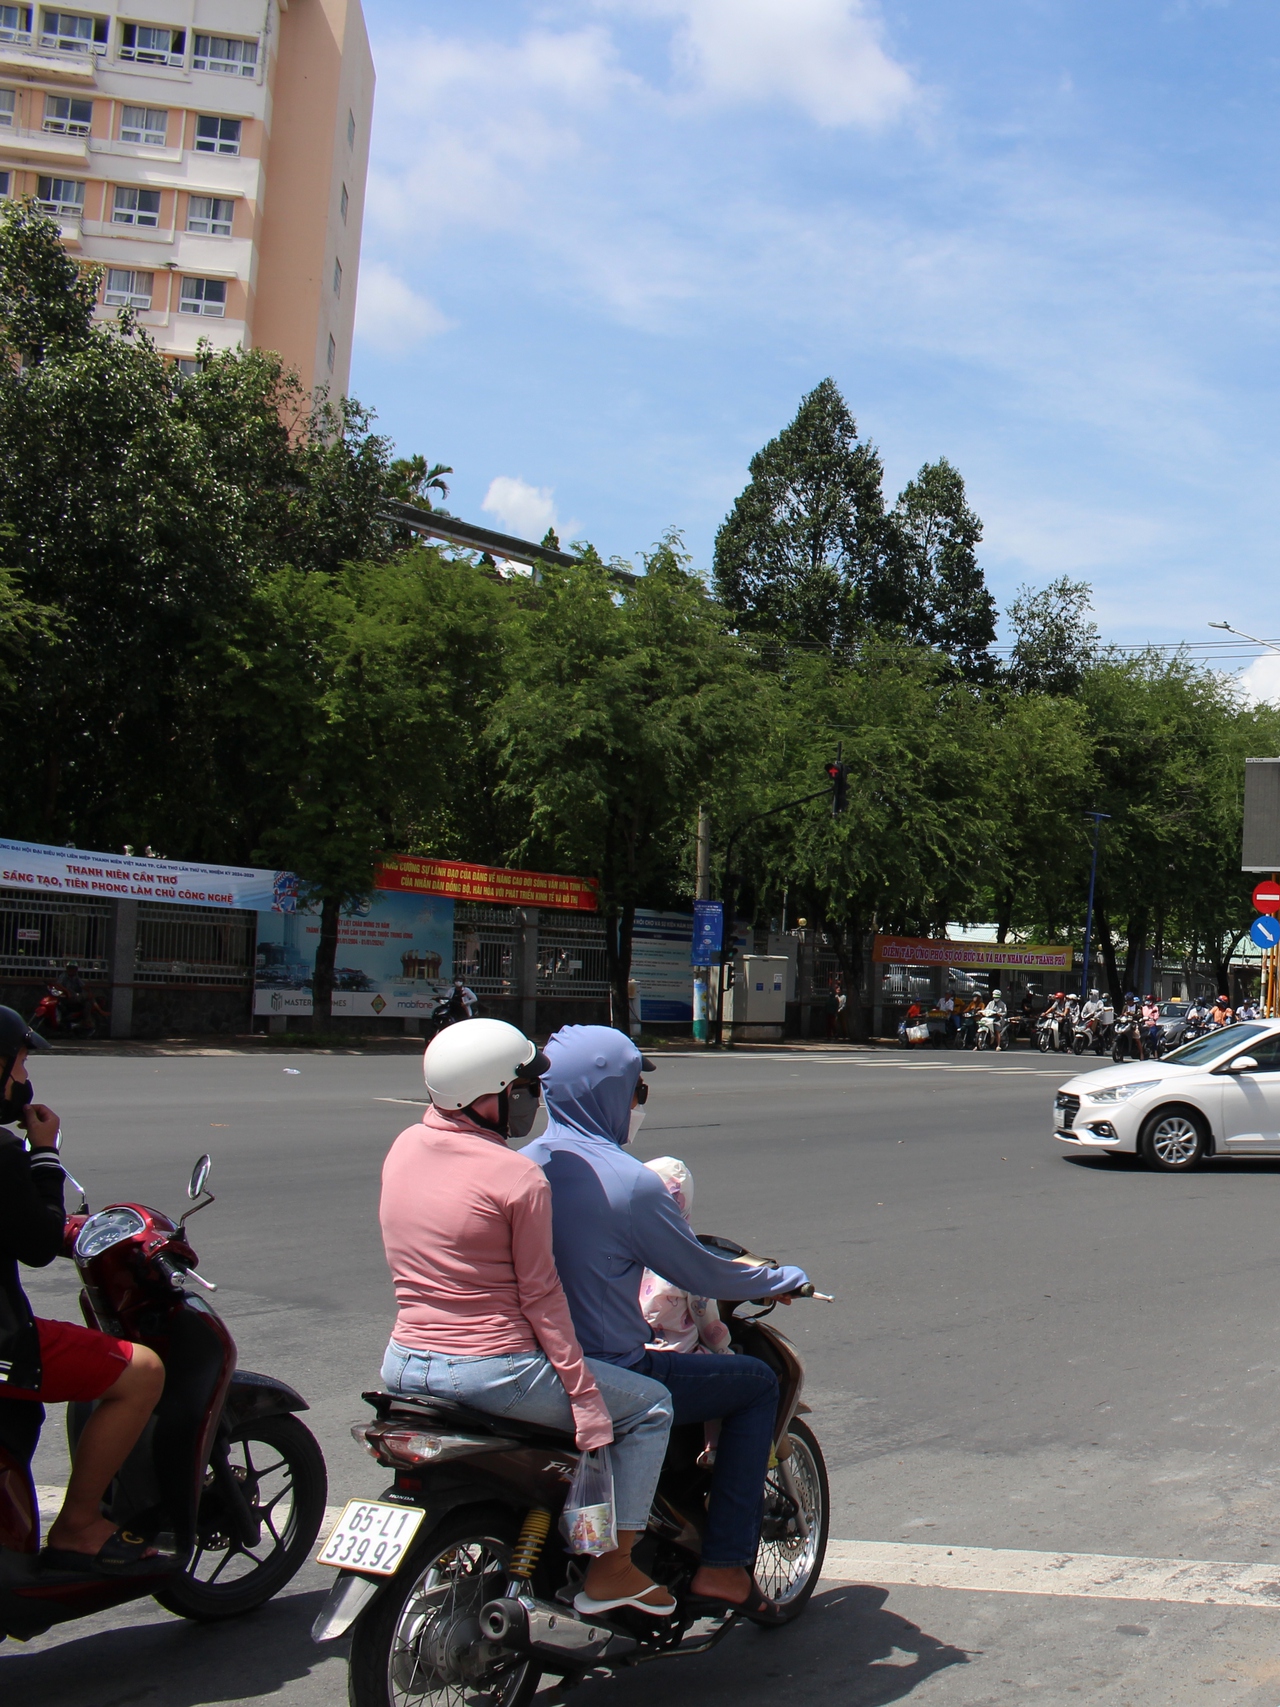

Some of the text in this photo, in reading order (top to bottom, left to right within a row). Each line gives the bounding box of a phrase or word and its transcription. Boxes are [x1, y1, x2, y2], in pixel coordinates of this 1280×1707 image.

[3, 870, 234, 906] SÁNG TẠO, TIÊN PHONG LÀM CHỦ CÔNG NGHỆ
[66, 865, 178, 885] THANH NIÊN CẦN THƠ
[400, 861, 420, 874] CƯỜNG
[421, 864, 430, 876] SỰ
[430, 865, 446, 877] LÃNH
[460, 868, 472, 880] CỦA
[472, 870, 488, 882] ĐẢNG
[496, 874, 511, 885] NÂNG
[512, 876, 522, 886] CAO
[534, 878, 548, 888] SỐNG
[401, 874, 412, 887] CỦA
[414, 878, 432, 889] NHÂN
[432, 880, 444, 890] DÂN
[445, 878, 462, 892] ĐỒNG
[496, 887, 505, 898] VỚI
[505, 888, 519, 898] PHÁT
[520, 888, 535, 900] TRIỂN
[536, 892, 548, 902] KINH
[548, 891, 555, 902] TẾ
[556, 893, 562, 903] VÀ
[882, 942, 900, 958] DIỄN
[900, 945, 915, 960] TẬP
[916, 945, 930, 960] ỨNG
[930, 947, 944, 960] PHÓ
[944, 948, 954, 964] SỰ
[954, 948, 963, 962] CỐ
[964, 948, 976, 962] BỨC
[986, 950, 994, 964] VÀ
[994, 953, 1006, 966] HẠT
[1007, 952, 1022, 964] NHÂN
[1035, 952, 1054, 966] THÀNH
[1054, 952, 1066, 966] PHỐ
[397, 1001, 433, 1009] mobifone
[389, 1494, 414, 1502] HONDA
[349, 1506, 410, 1538] 65-L1
[326, 1534, 402, 1570] 339.92
